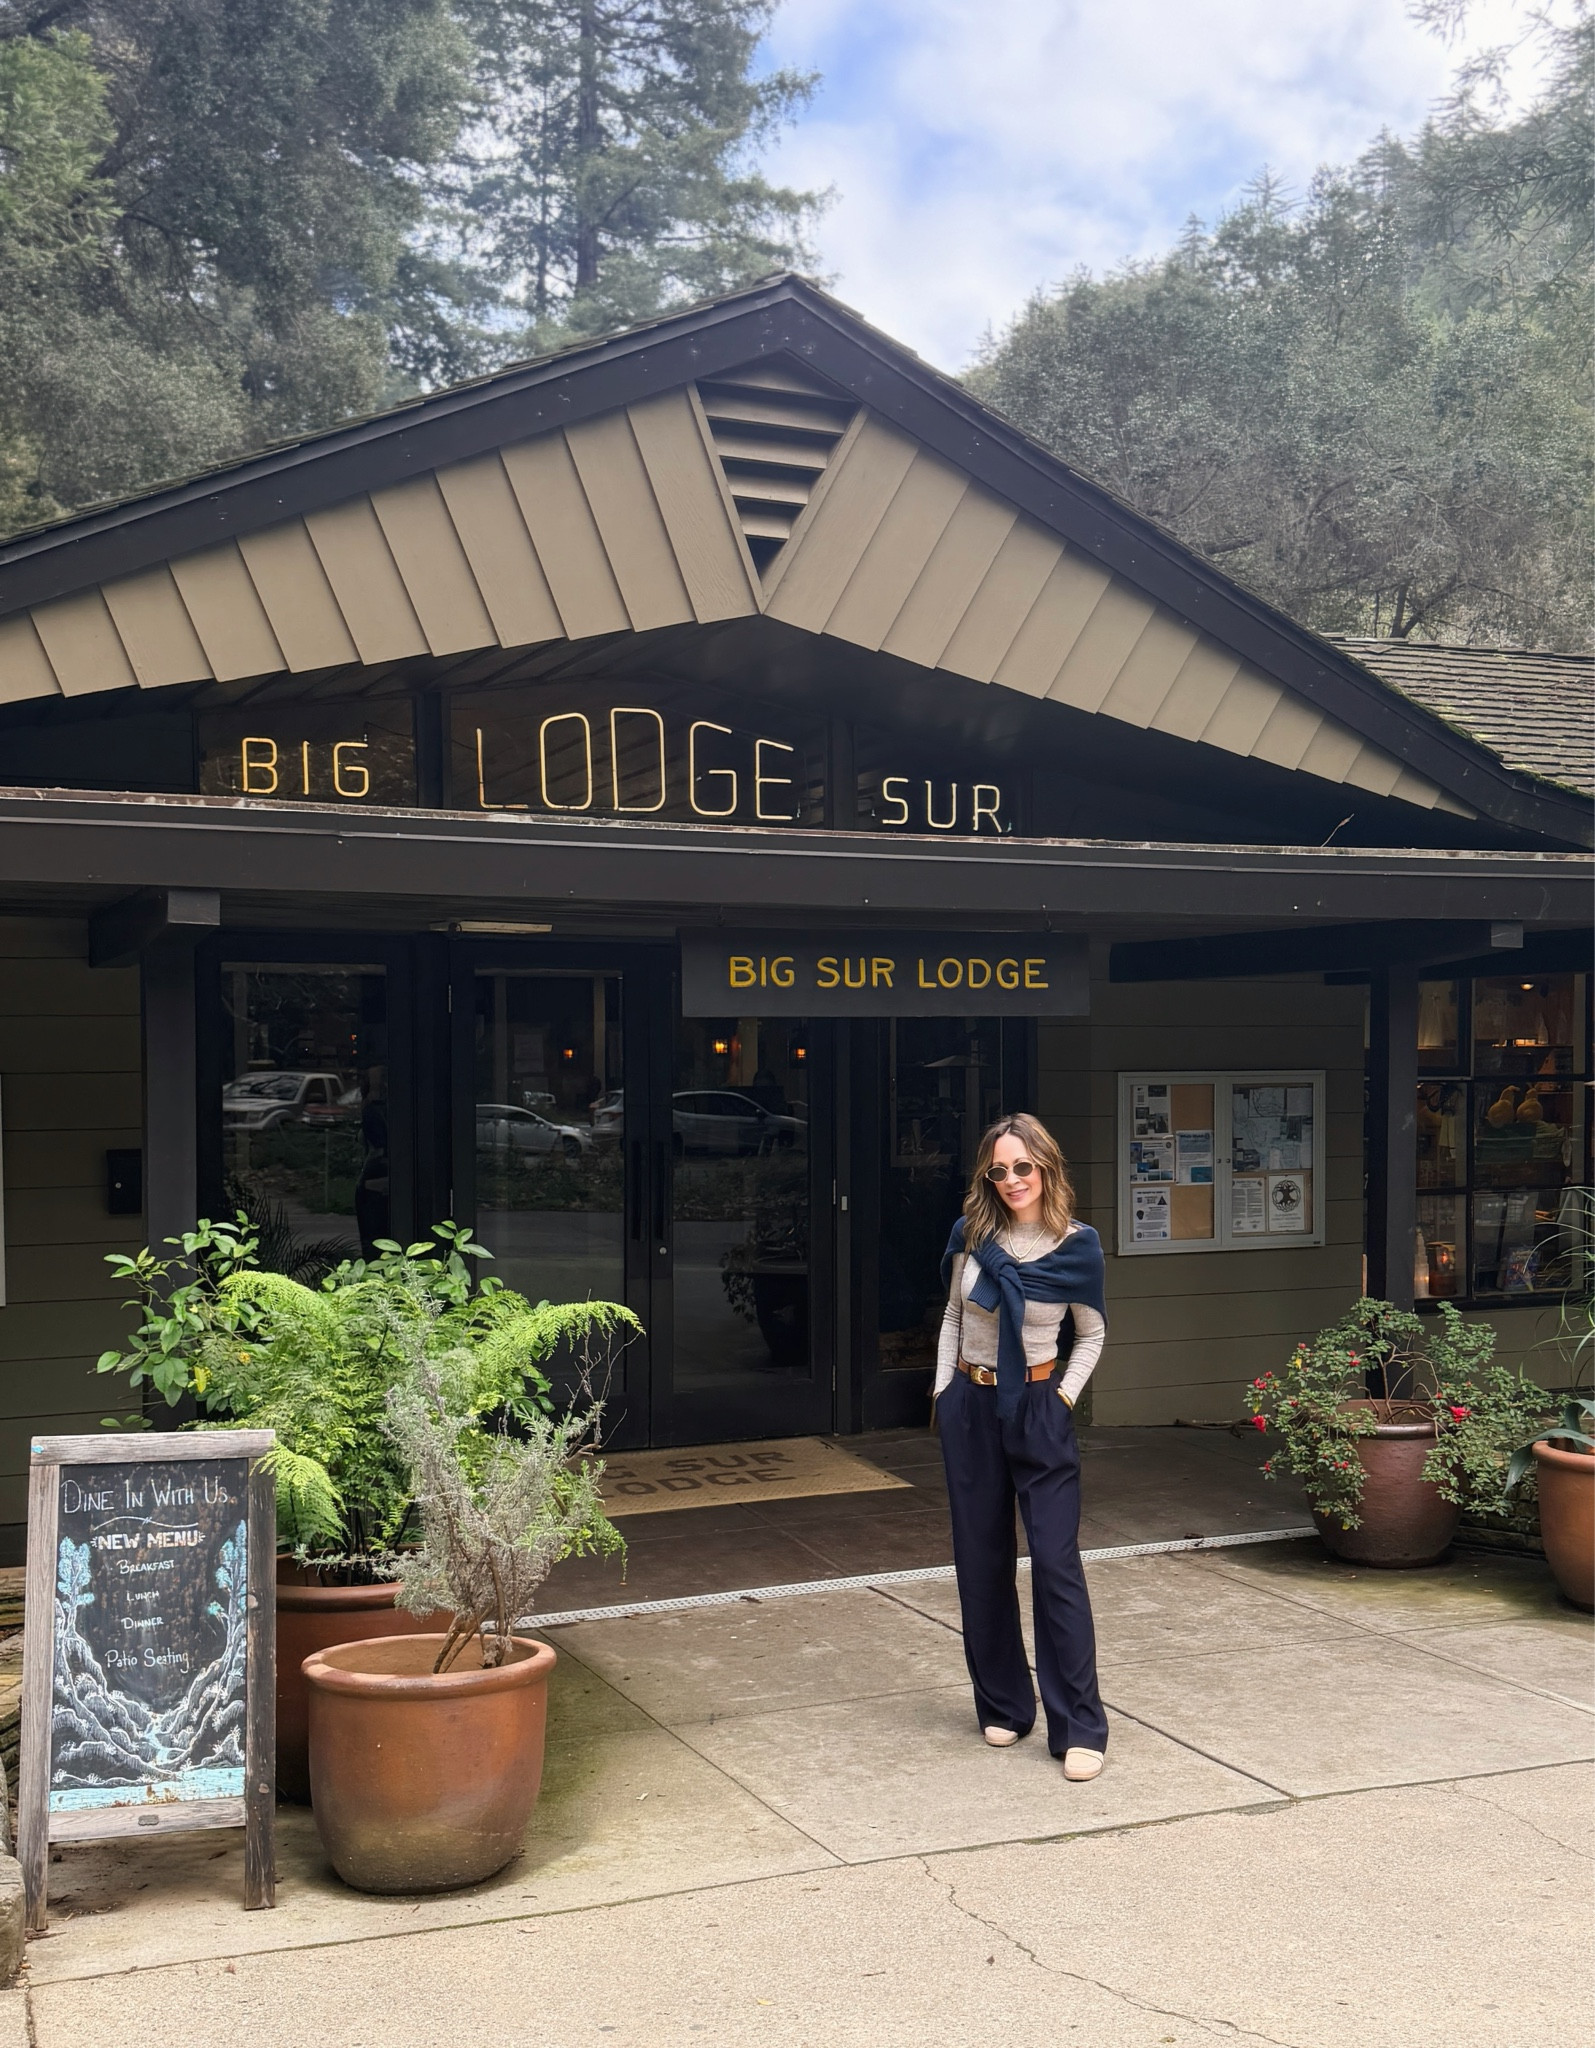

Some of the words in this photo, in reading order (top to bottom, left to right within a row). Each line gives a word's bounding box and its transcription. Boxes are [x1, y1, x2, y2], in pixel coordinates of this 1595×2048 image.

[242, 736, 370, 798] BIG
[476, 707, 794, 820] LODGE
[882, 776, 1003, 833] SUR
[729, 956, 796, 988] BIG
[816, 956, 896, 989] SUR
[918, 957, 1050, 990] LODGE
[664, 1451, 795, 1474] SUR
[61, 1479, 115, 1514] DINE
[125, 1478, 144, 1509] IN
[151, 1478, 195, 1507] WITH
[598, 1467, 797, 1499] ODGE
[97, 1532, 141, 1551] NEW
[146, 1529, 199, 1549] MENU
[104, 1649, 138, 1668] Patio
[143, 1647, 190, 1674] Seating
